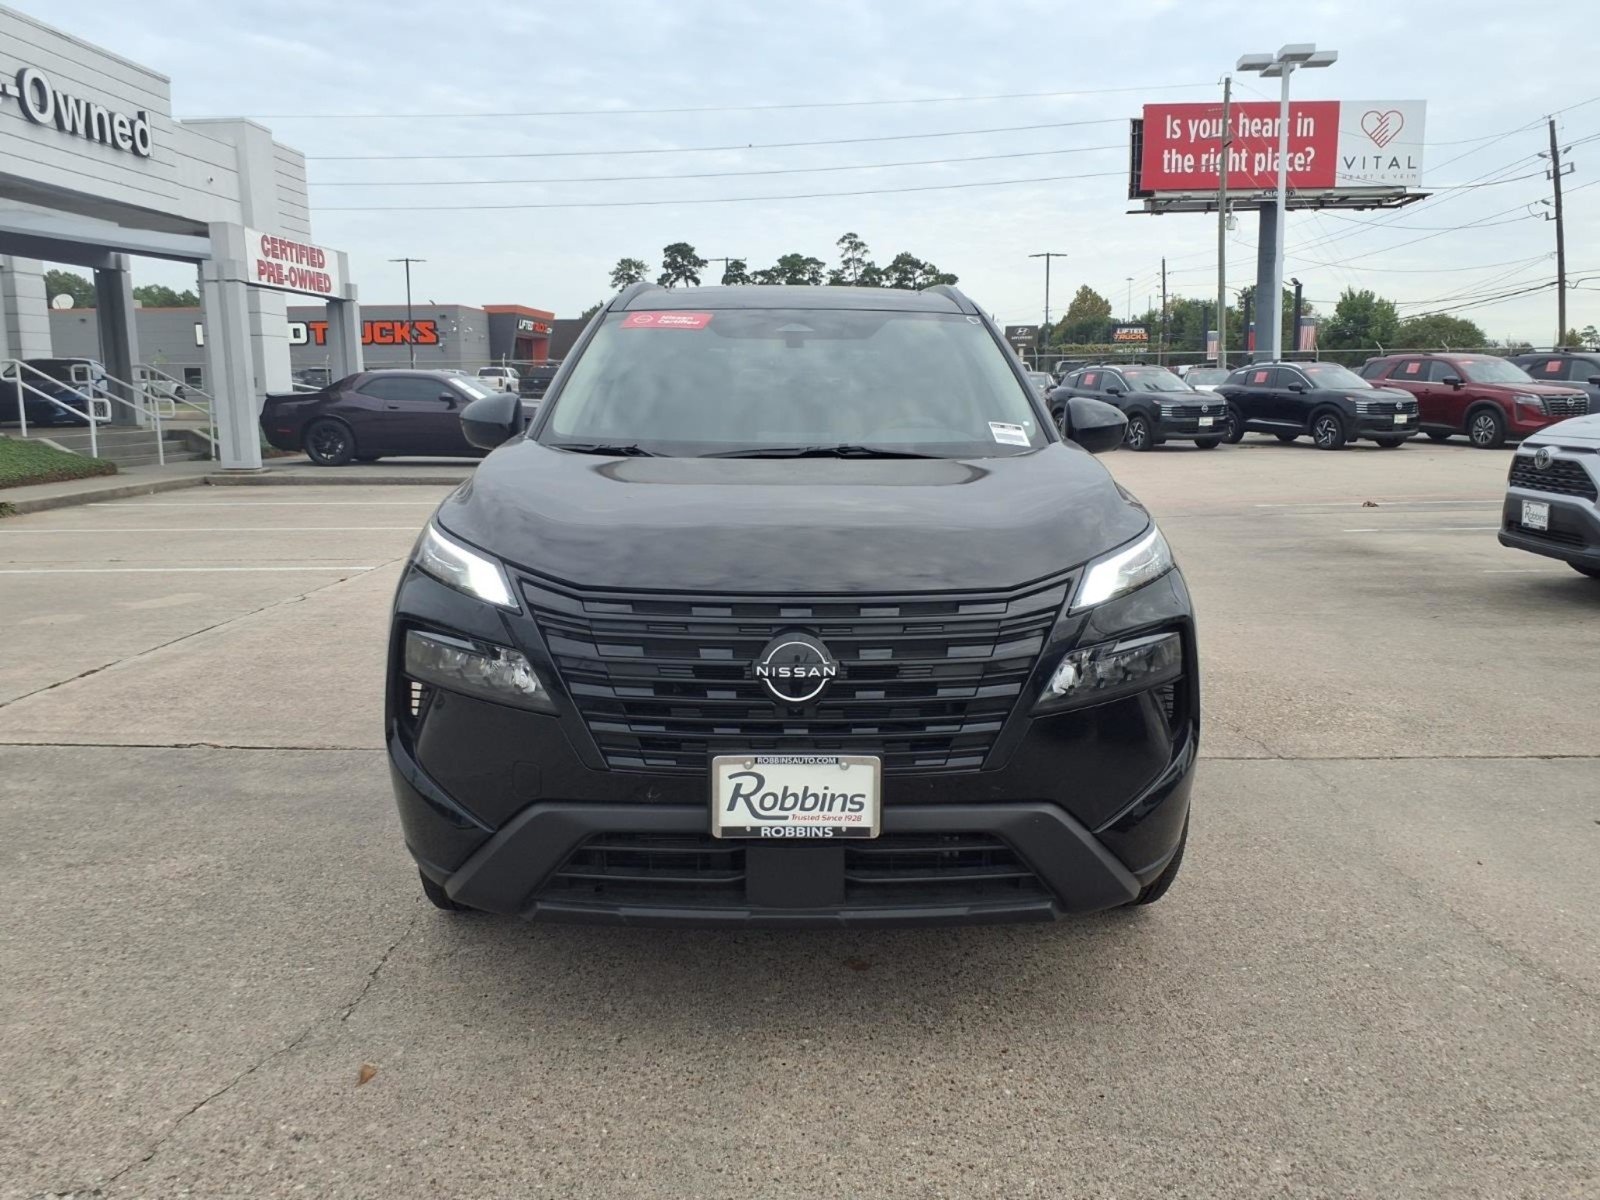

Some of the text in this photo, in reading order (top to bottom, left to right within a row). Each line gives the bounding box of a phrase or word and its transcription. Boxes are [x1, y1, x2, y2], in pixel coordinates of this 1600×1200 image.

[0, 67, 153, 157] -Owned
[1165, 114, 1182, 140] Is
[1188, 118, 1233, 143] your
[1296, 111, 1315, 138] in
[1163, 148, 1195, 174] the
[1254, 146, 1316, 177] place?
[1343, 155, 1417, 170] VITAL
[260, 234, 326, 269] CERTIFIED
[256, 258, 332, 294] PRE-OWNED
[1113, 333, 1149, 341] TRUCKS
[756, 666, 836, 677] NISSAN
[756, 756, 837, 765] ROBBINSAUTO.COM
[726, 771, 866, 821] Robbins
[844, 814, 863, 822] 1928
[760, 826, 834, 838] ROBBINS
